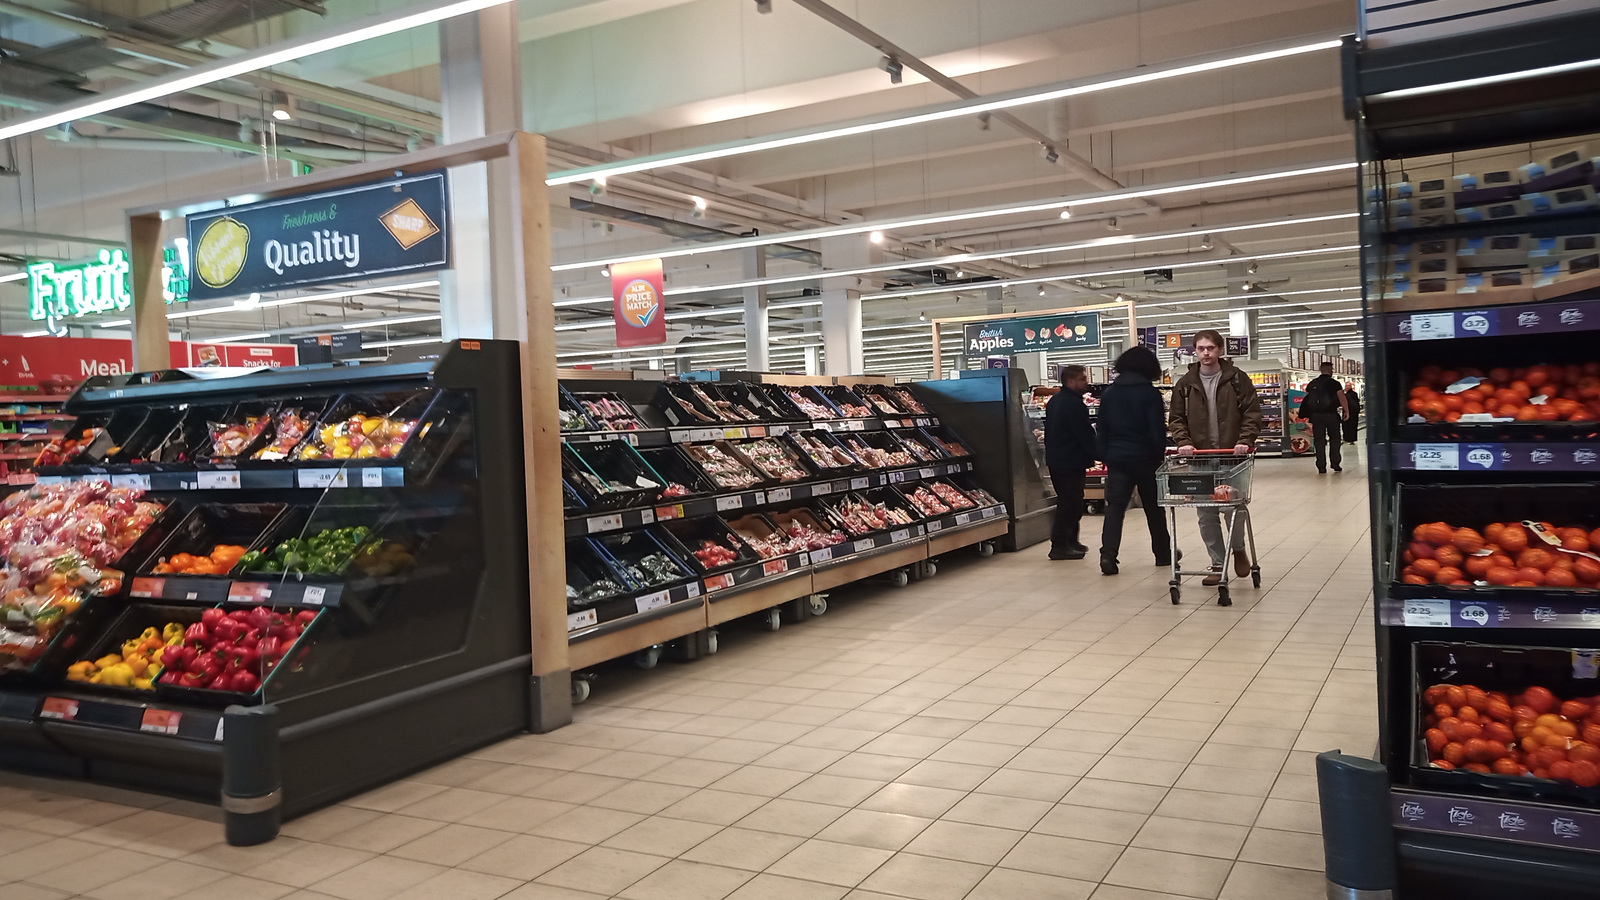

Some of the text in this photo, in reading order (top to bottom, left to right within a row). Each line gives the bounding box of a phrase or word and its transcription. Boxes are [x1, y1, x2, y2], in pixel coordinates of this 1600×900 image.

[282, 203, 338, 231] Freshness &
[391, 213, 425, 233] SHARP
[264, 229, 361, 275] Quality
[28, 249, 131, 320] Fruit
[626, 292, 652, 302] PRICE
[627, 301, 652, 311] MATCH
[979, 327, 1004, 339] British
[1170, 336, 1177, 345] 2
[969, 336, 1014, 353] Apples
[80, 358, 126, 377] Meal
[243, 358, 281, 368] Snacks for
